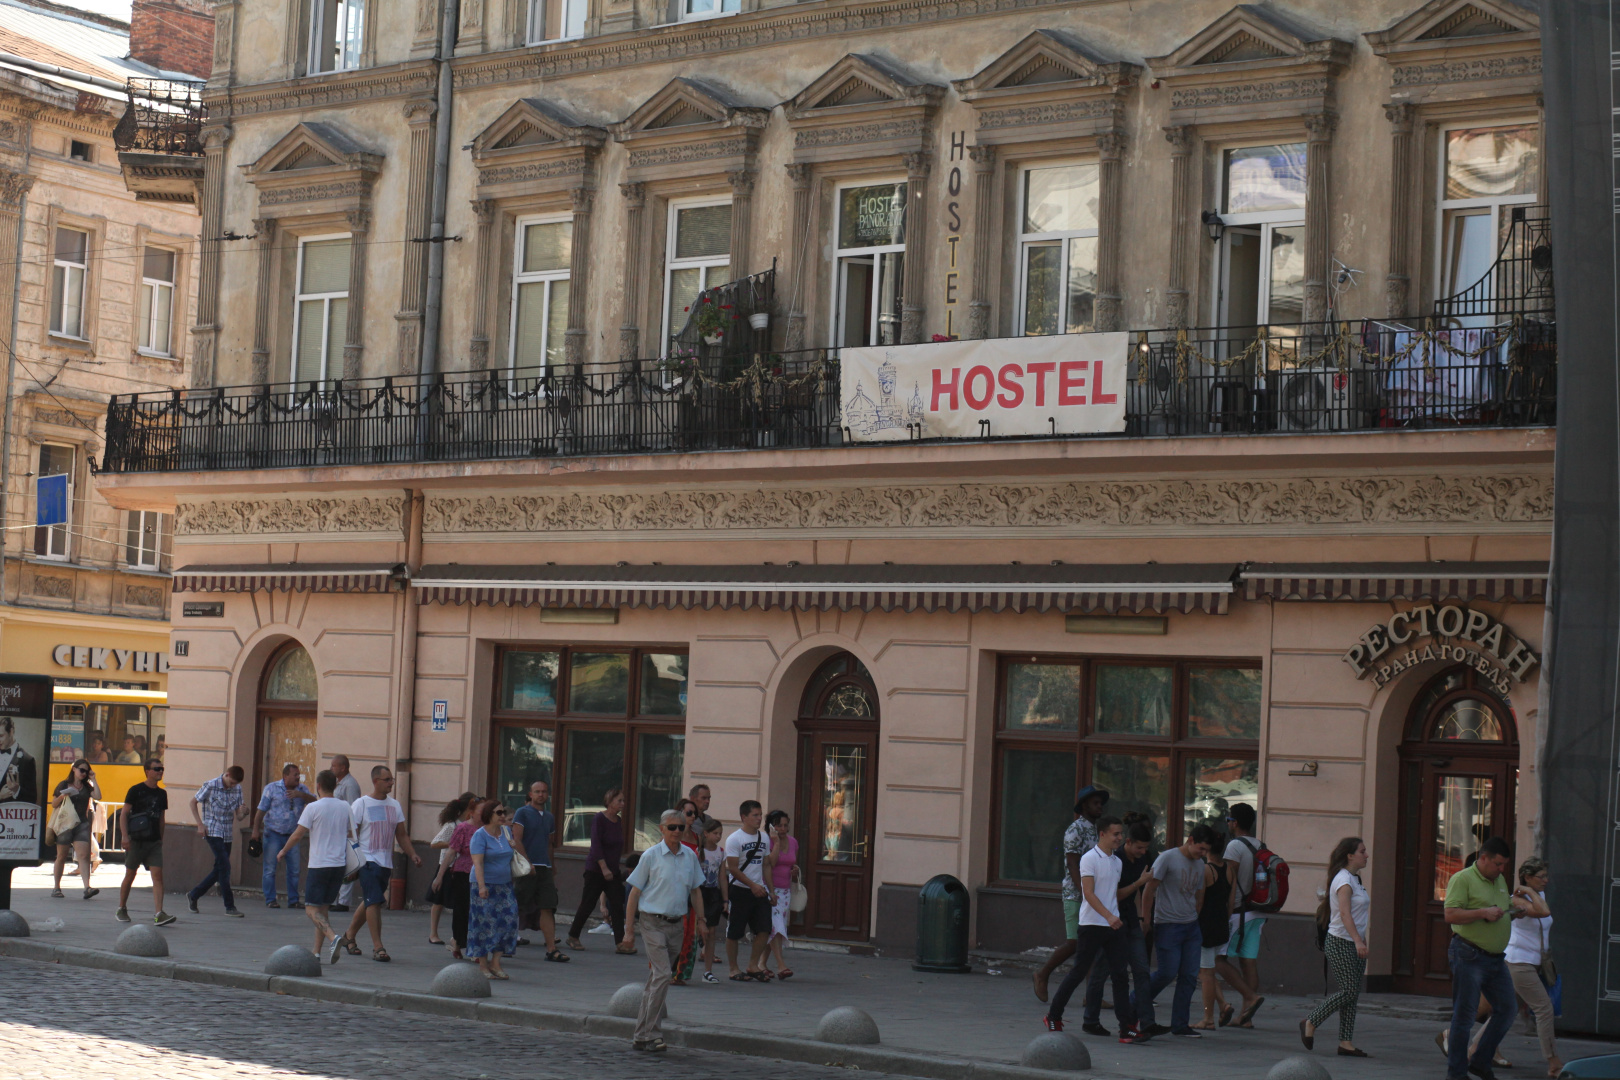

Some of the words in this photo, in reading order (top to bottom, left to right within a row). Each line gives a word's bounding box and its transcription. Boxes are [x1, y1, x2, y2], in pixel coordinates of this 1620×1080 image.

[859, 196, 902, 214] HOSTEL
[944, 130, 966, 342] HOSTEL
[930, 360, 1118, 412] HOSTEL
[177, 643, 185, 655] 11
[1341, 604, 1537, 682] РЕСТОРАН
[1371, 645, 1436, 691] ГРАНД
[1440, 644, 1512, 694] ГОТЕЛЬ
[58, 734, 72, 744] 838
[28, 823, 36, 839] 1
